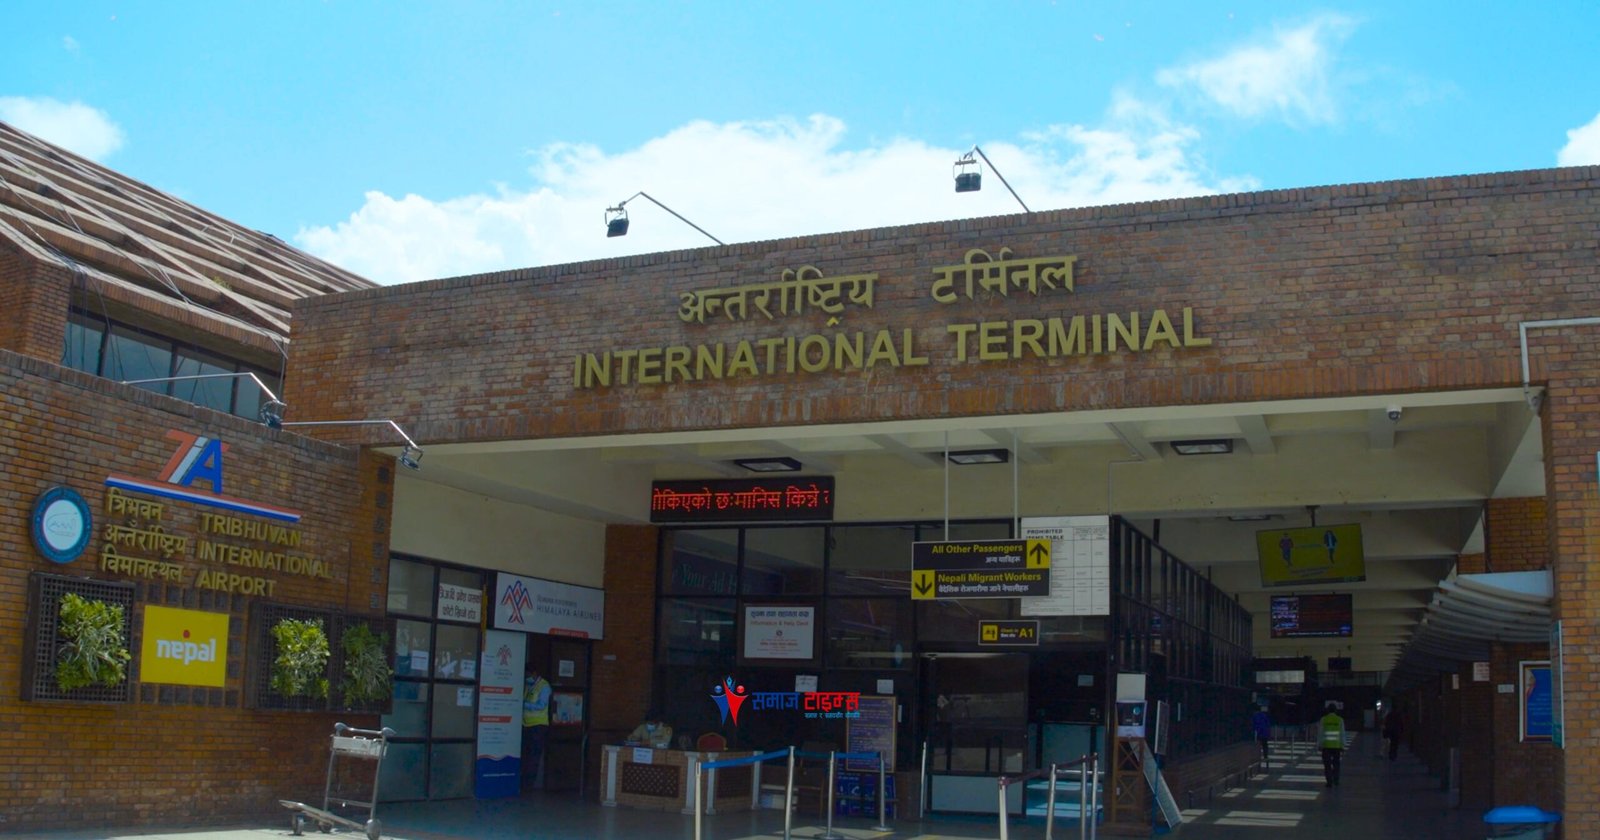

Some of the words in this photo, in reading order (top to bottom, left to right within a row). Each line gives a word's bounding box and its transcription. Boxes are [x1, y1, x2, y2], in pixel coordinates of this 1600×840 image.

[931, 247, 1079, 304] टर्मिनल
[573, 327, 930, 390] INTERNATIONAL
[947, 306, 1213, 364] TERMINAL
[198, 512, 304, 547] TRIBHUVAN
[101, 543, 185, 582] विमानस्थल
[197, 539, 333, 580] INTERNATIONAL
[931, 545, 944, 554] All
[945, 544, 971, 554] Other
[973, 544, 1023, 555] Passengers
[195, 569, 277, 597] AIRPORT
[938, 573, 967, 584] Nepali
[968, 573, 1003, 584] Migrant
[1004, 572, 1042, 582] Workers
[536, 604, 571, 616] HIMALAYA
[572, 609, 602, 622] AIRLINES
[1019, 627, 1034, 639] A1
[155, 637, 217, 666] nepal
